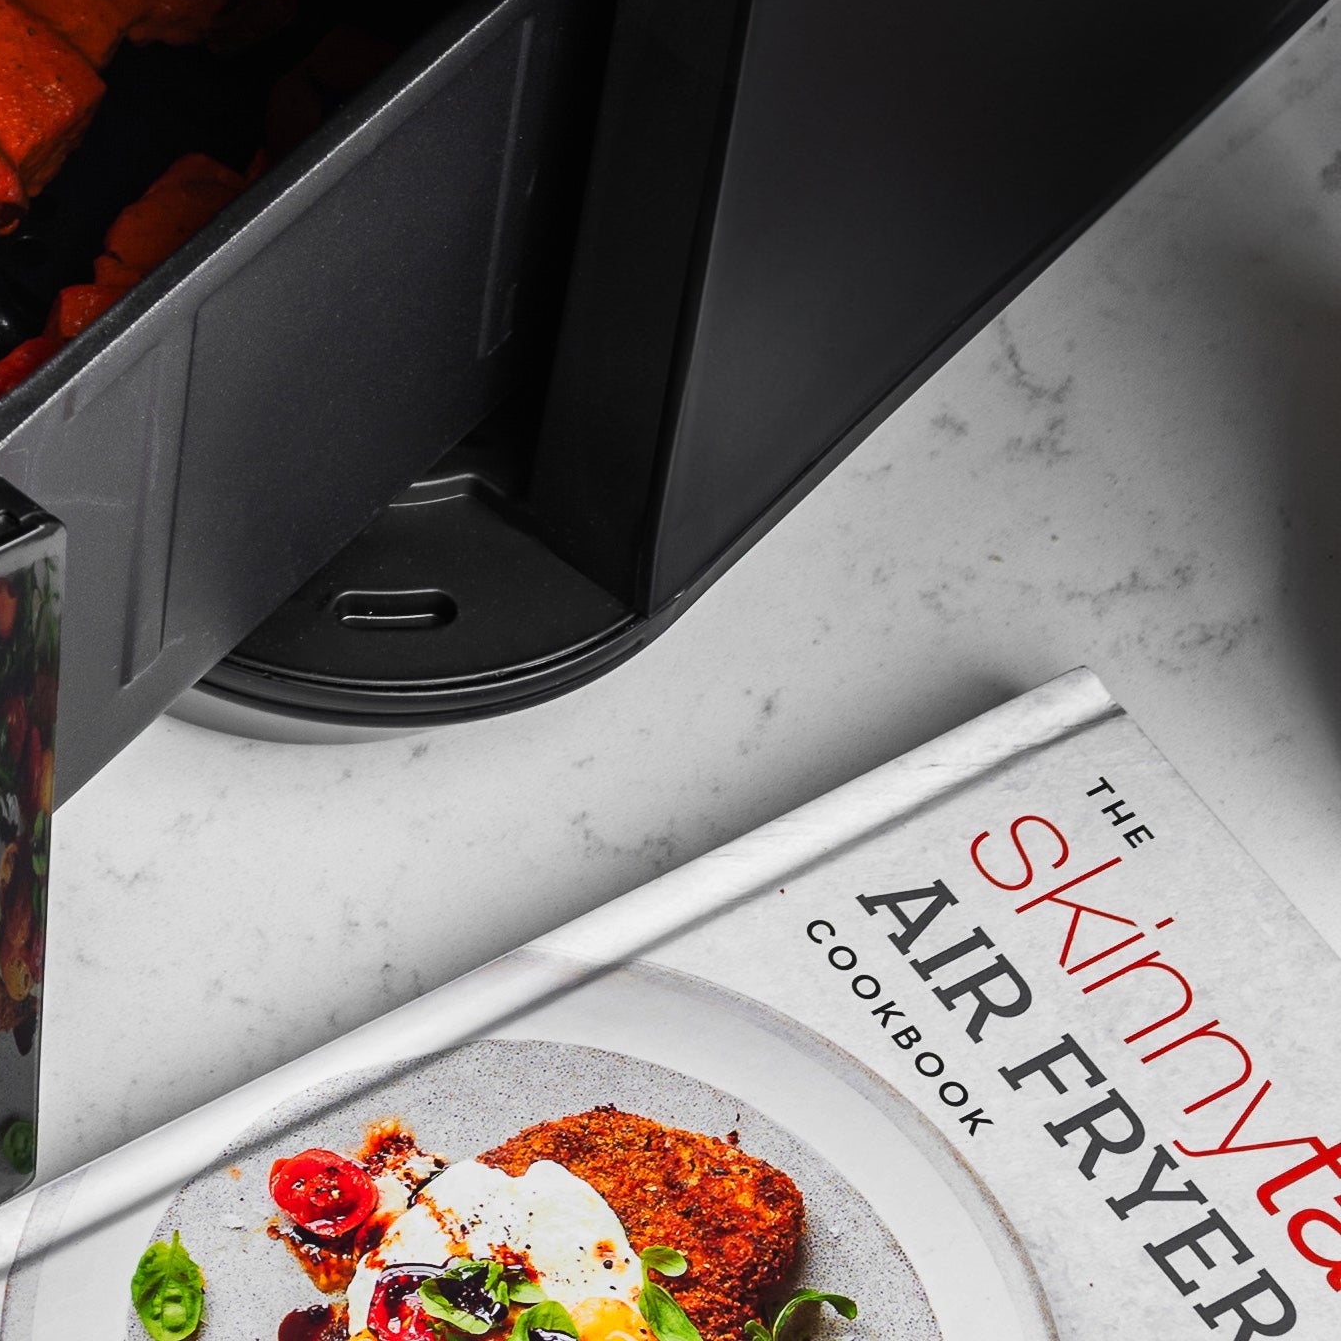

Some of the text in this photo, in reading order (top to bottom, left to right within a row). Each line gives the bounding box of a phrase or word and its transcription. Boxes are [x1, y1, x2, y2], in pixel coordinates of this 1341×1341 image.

[1085, 776, 1155, 849] THE
[806, 919, 994, 1137] COOKBOOK
[855, 878, 1297, 1341] AIR FRYER
